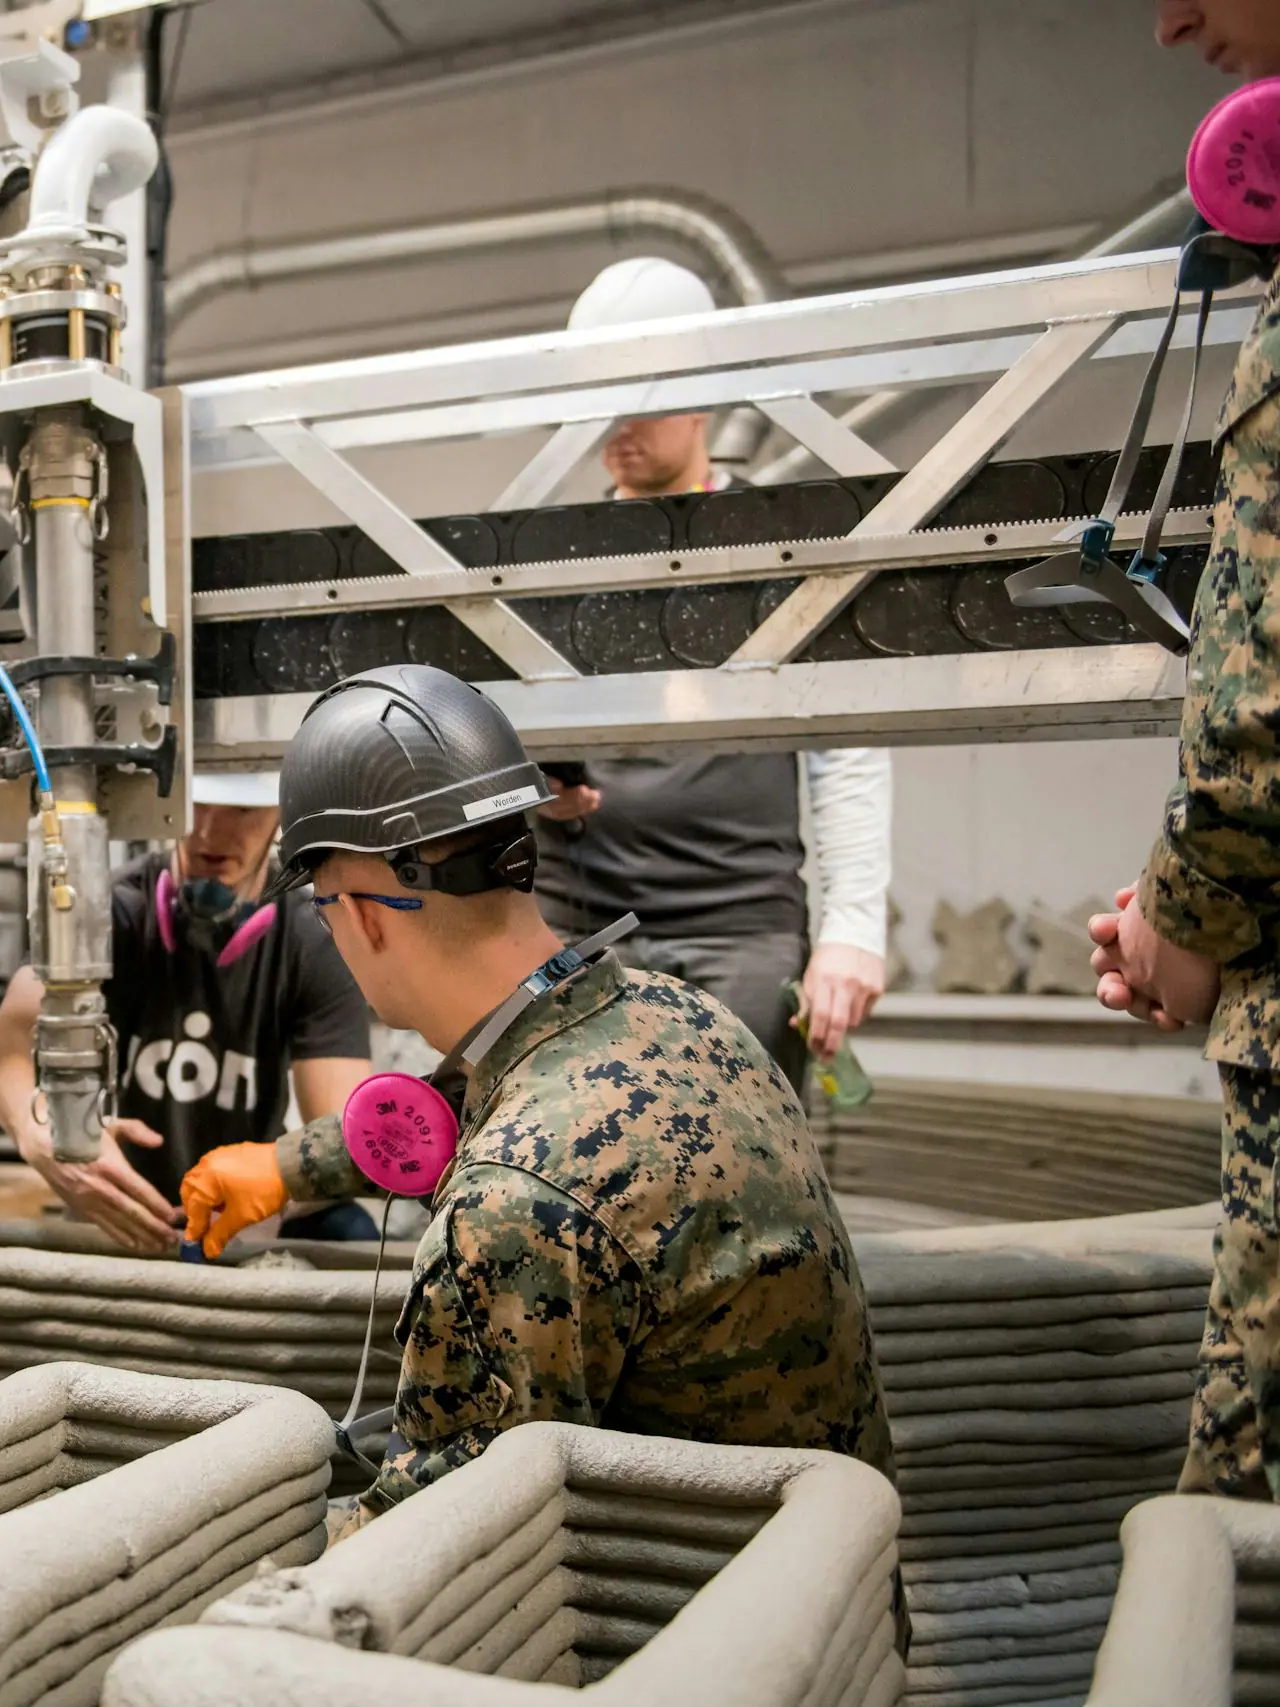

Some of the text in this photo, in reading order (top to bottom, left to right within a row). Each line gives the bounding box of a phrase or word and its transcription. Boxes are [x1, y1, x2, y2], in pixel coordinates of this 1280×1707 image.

[493, 795, 522, 808] Worden
[376, 1100, 397, 1115] 3M
[404, 1106, 433, 1145] 2091
[363, 1129, 392, 1169] 2091
